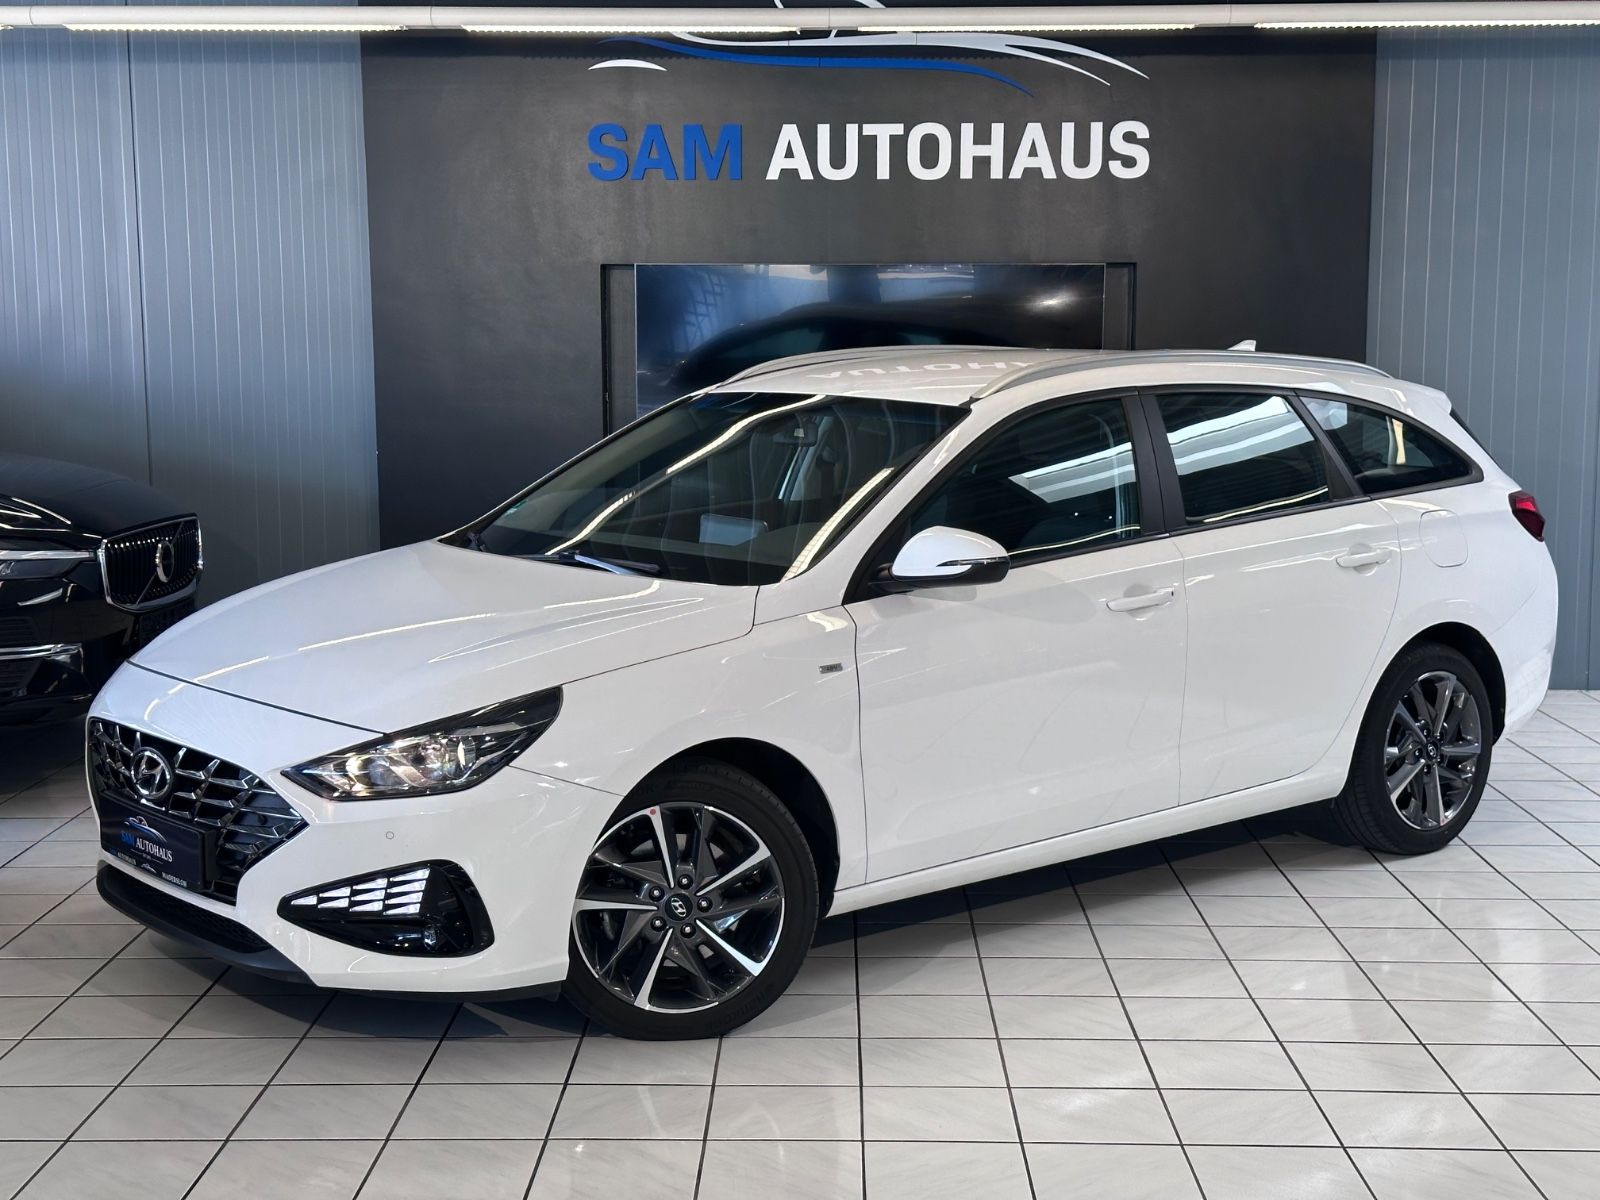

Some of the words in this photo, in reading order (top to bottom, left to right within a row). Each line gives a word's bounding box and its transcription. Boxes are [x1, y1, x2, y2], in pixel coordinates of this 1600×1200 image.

[587, 123, 743, 181] SAM
[766, 120, 1151, 181] AUTOHAUS
[136, 837, 173, 862] AUTOHAUS
